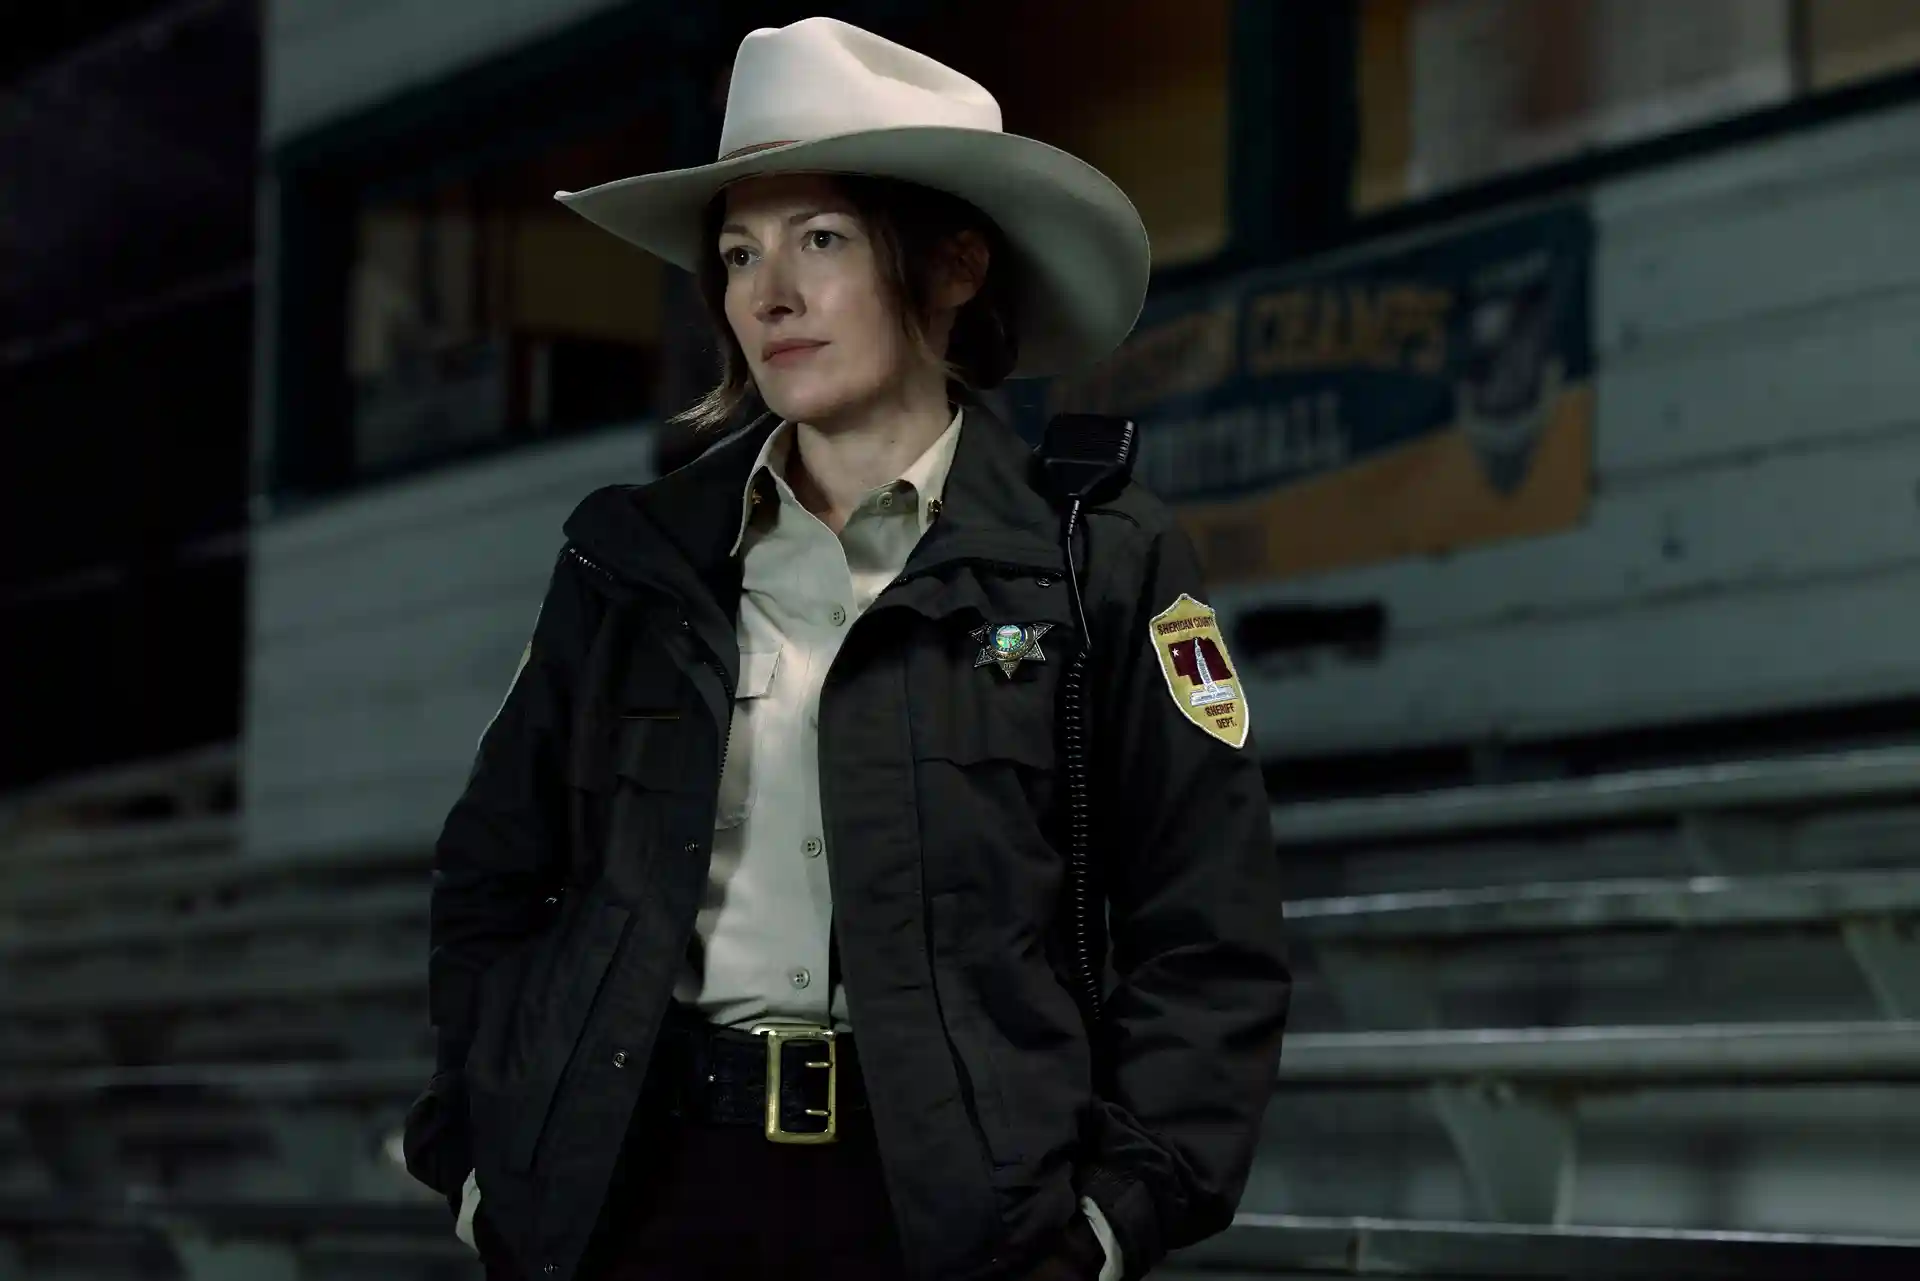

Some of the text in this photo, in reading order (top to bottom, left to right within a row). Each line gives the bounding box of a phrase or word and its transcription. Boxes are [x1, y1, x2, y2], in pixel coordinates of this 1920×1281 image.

[1251, 282, 1453, 375] CHAMPS
[1157, 618, 1194, 635] SHERIDAN
[1205, 703, 1235, 717] SHERIFF
